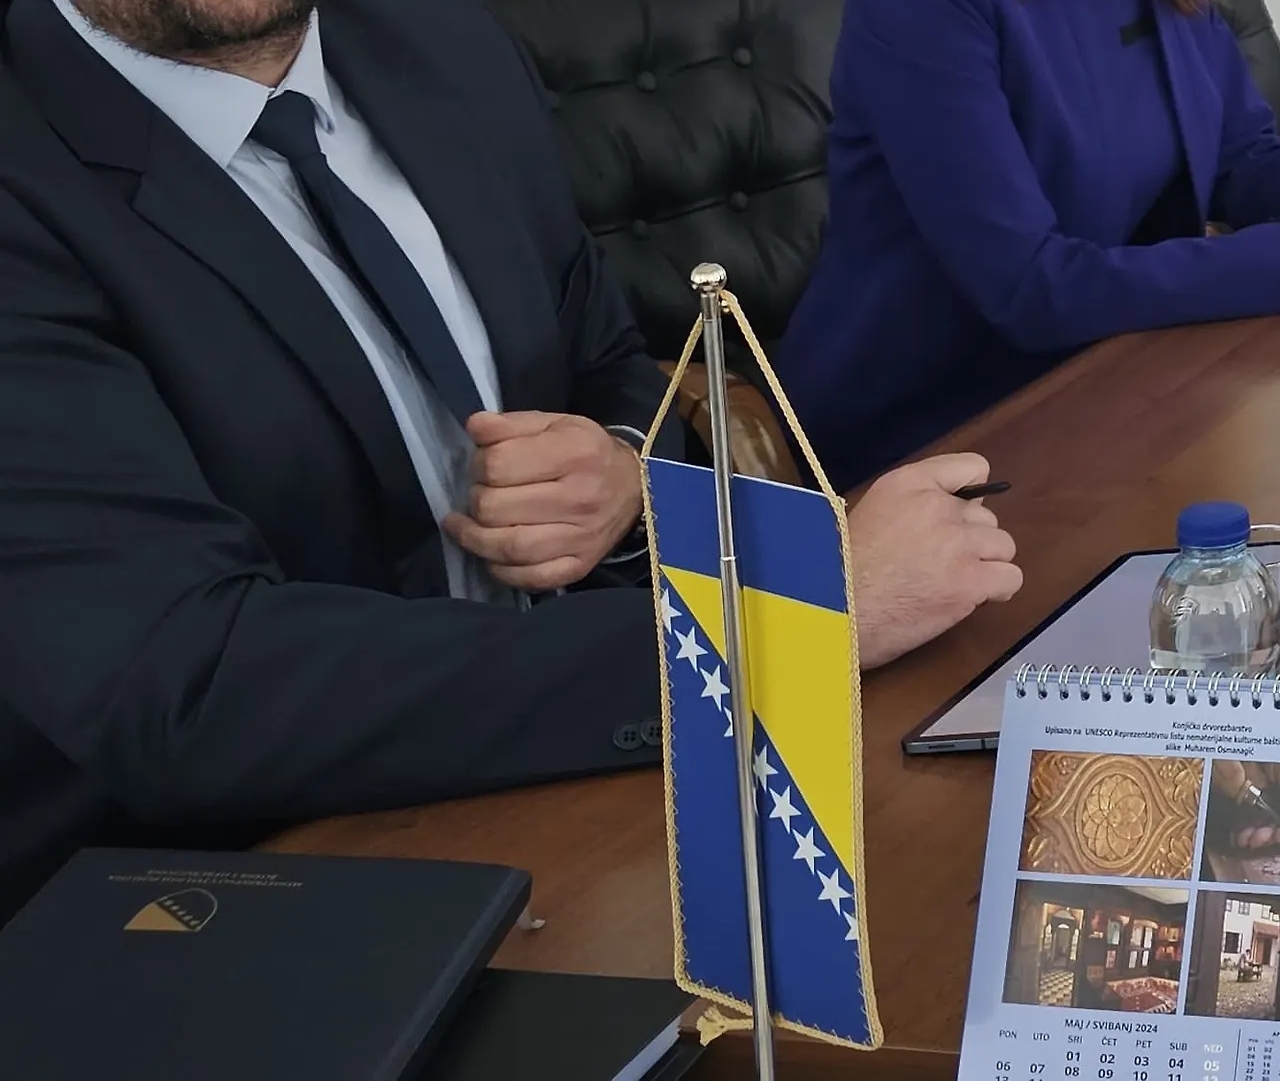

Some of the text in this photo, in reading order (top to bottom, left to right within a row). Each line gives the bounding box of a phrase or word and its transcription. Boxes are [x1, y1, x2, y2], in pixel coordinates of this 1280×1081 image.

[1045, 726, 1072, 735] Upisano
[1085, 728, 1113, 736] UNESCO
[1114, 730, 1168, 739] Reprezentativnu
[1186, 734, 1232, 743] nematerijalne
[1234, 735, 1261, 743] kulturne
[1185, 744, 1215, 752] Muharem
[1217, 746, 1254, 756] Osmanagić
[1065, 1019, 1084, 1030] MAJ
[1093, 1021, 1132, 1033] SVIBANJ
[1136, 1023, 1158, 1033] 2024
[999, 1030, 1223, 1053] PON UTO SRI ČET PET SUB NED
[1067, 1051, 1219, 1071] 01 02 03 04 05
[996, 1061, 1011, 1071] 06
[1030, 1063, 1045, 1073] 07
[1065, 1066, 1079, 1076] 08
[1098, 1069, 1113, 1079] 09
[1133, 1071, 1147, 1081] 10
